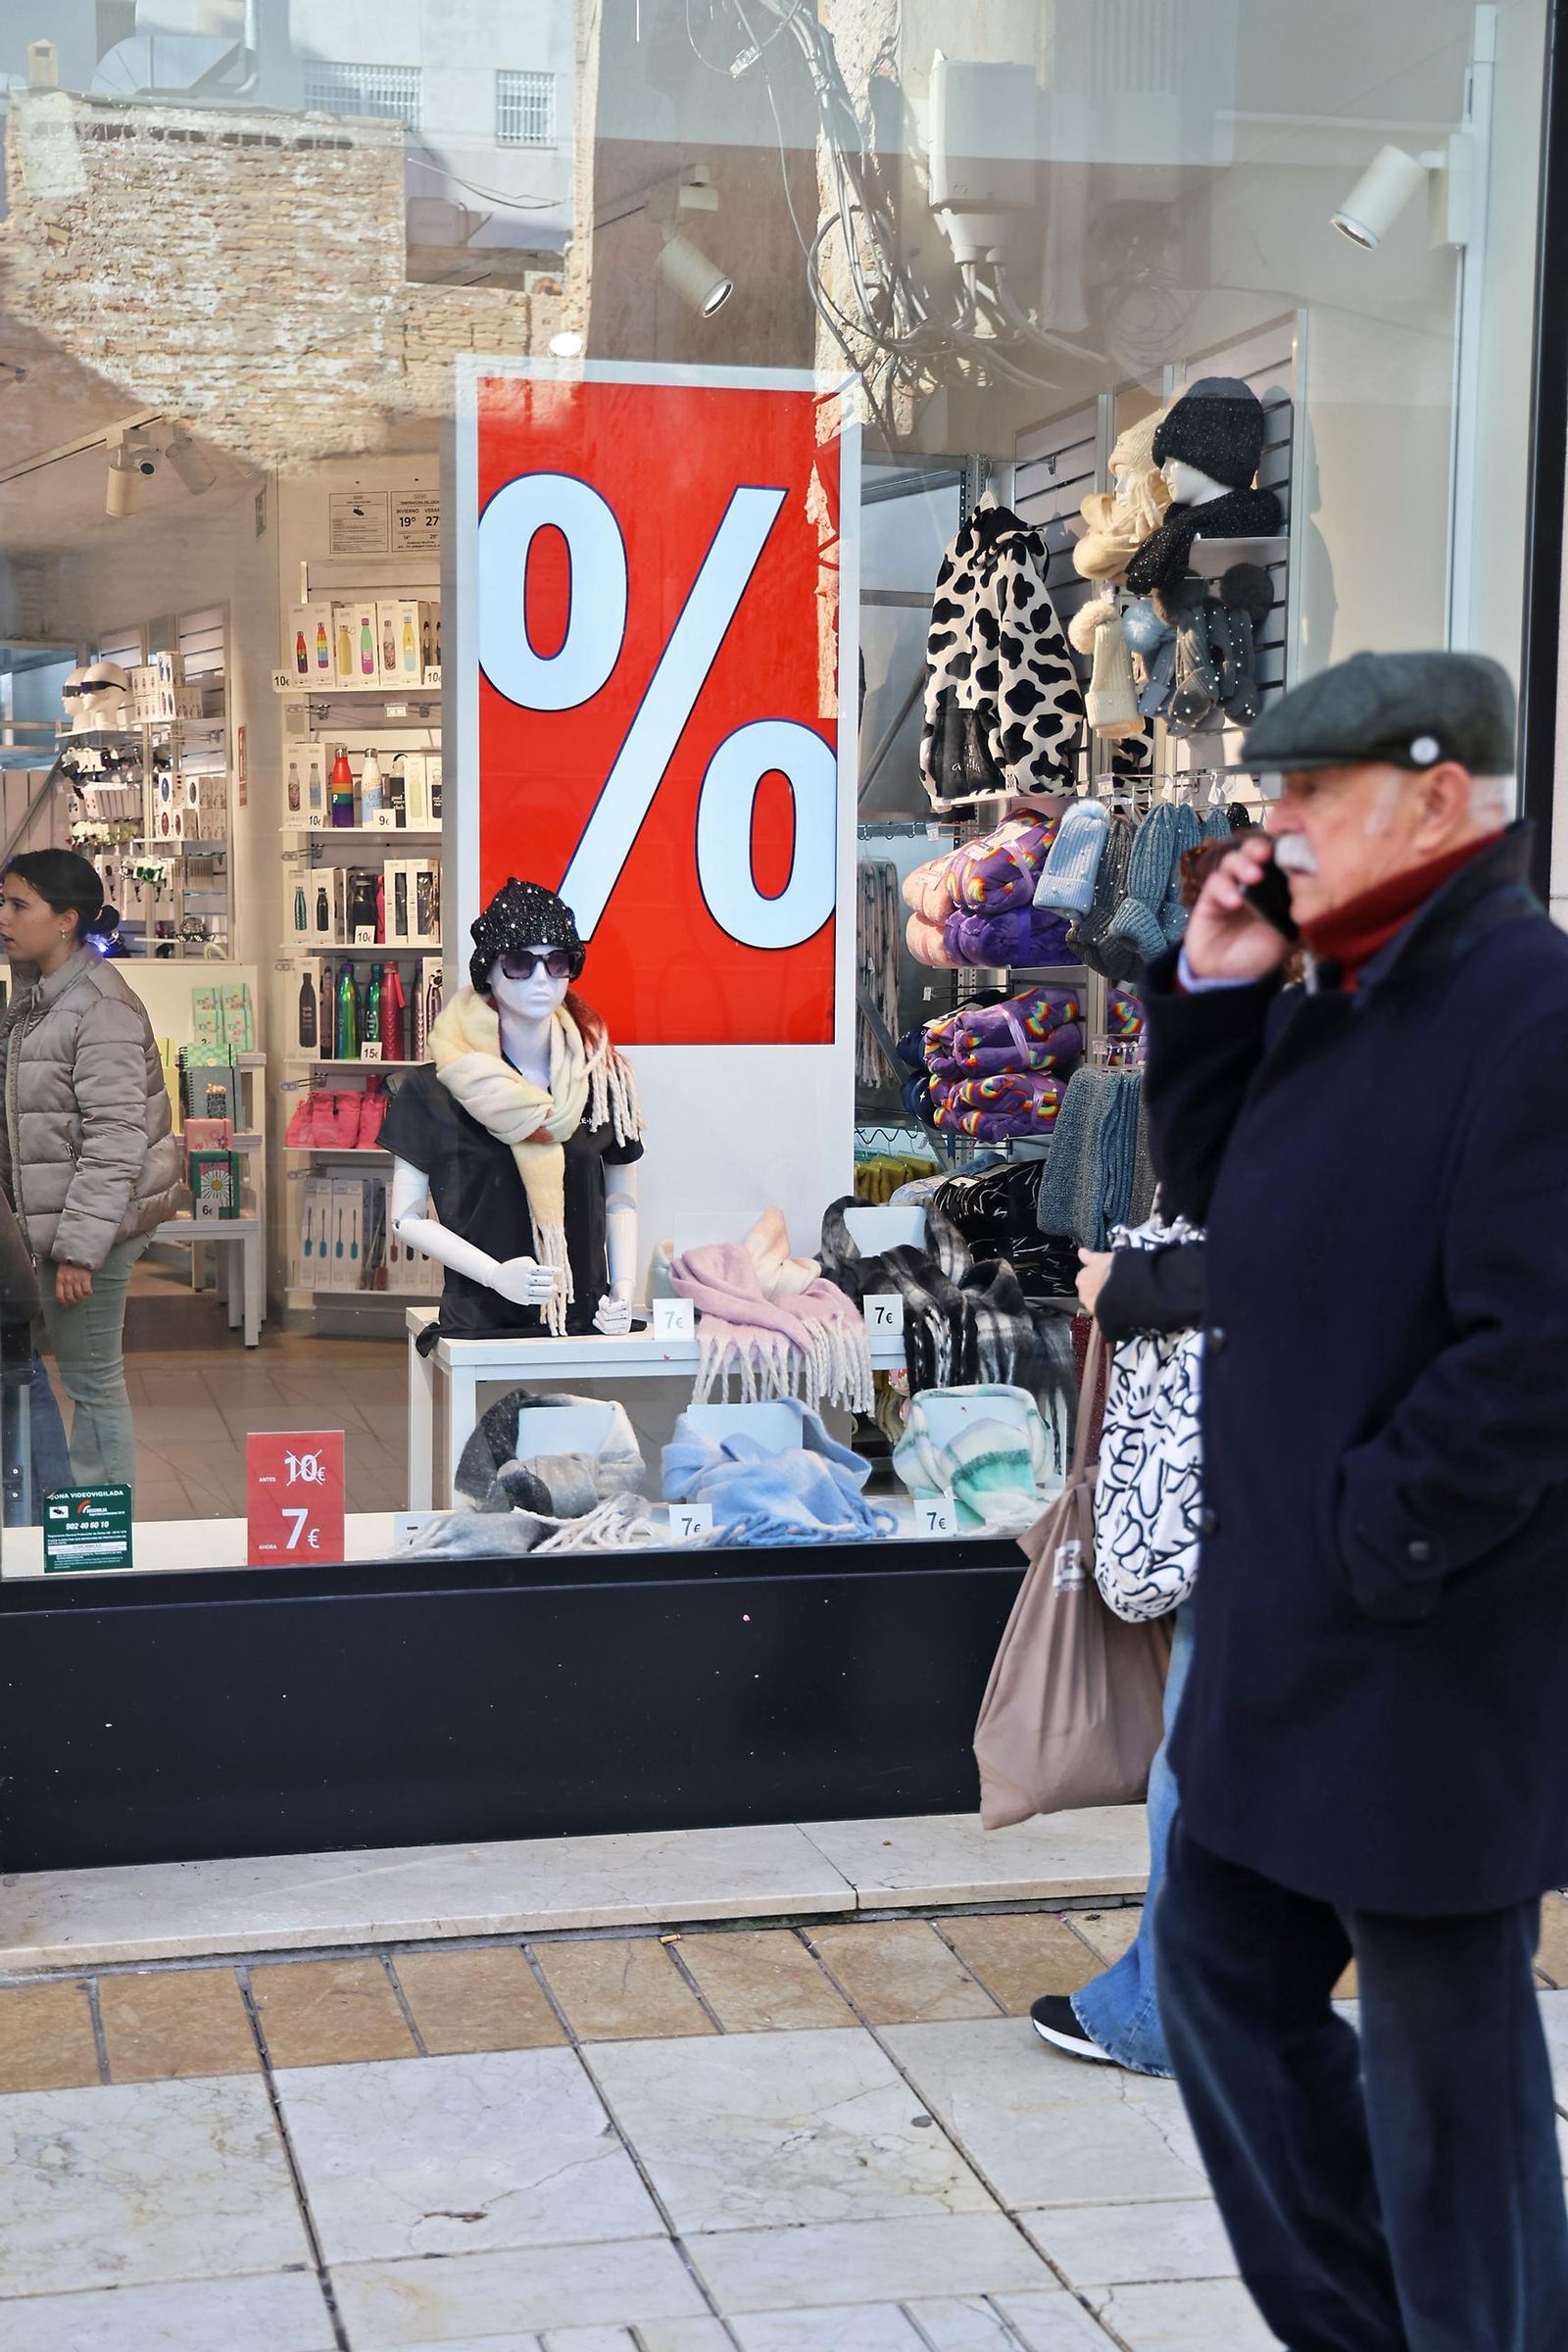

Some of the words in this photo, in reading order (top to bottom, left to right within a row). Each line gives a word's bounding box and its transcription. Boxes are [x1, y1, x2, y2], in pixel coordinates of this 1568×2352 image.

[400, 516, 416, 527] 19°
[274, 675, 290, 686] 10€
[475, 471, 838, 950] %
[309, 814, 321, 826] 10€
[378, 814, 390, 826] 9€
[357, 931, 371, 943] 10€
[364, 1048, 378, 1058] 15€
[202, 1204, 213, 1215] 6€
[664, 1310, 684, 1329] 7€
[874, 1306, 894, 1325] 7€
[284, 1454, 326, 1483] 10€
[71, 1490, 124, 1498] VIDEOVIGILADA
[926, 1511, 946, 1531] 7€
[281, 1507, 320, 1549] 7€
